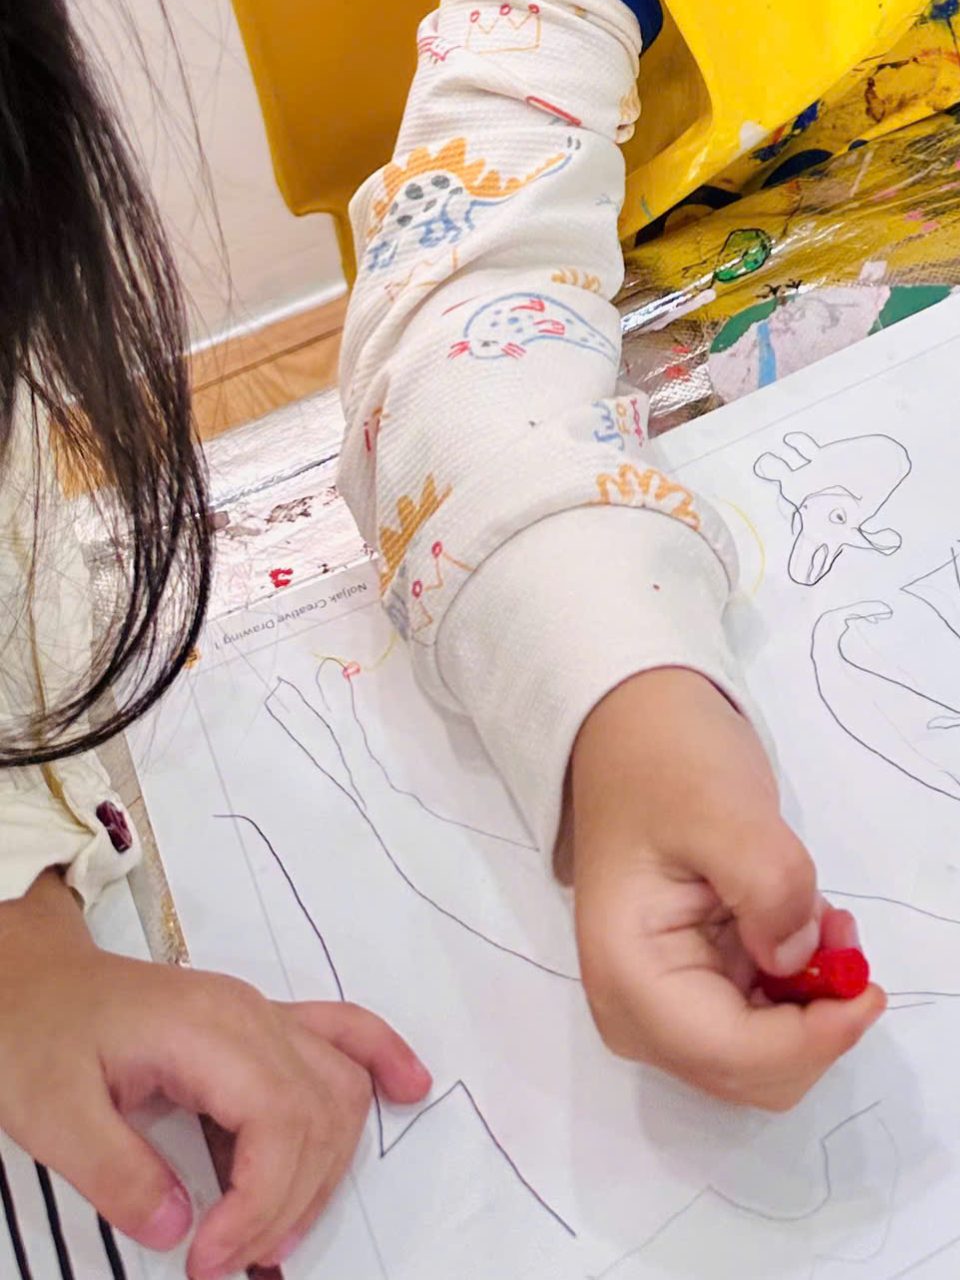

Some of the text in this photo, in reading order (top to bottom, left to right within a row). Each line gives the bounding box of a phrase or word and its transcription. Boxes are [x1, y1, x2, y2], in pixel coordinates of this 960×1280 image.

[331, 582, 368, 605] Noljak
[279, 599, 328, 623] Creative
[222, 620, 277, 646] Drawing
